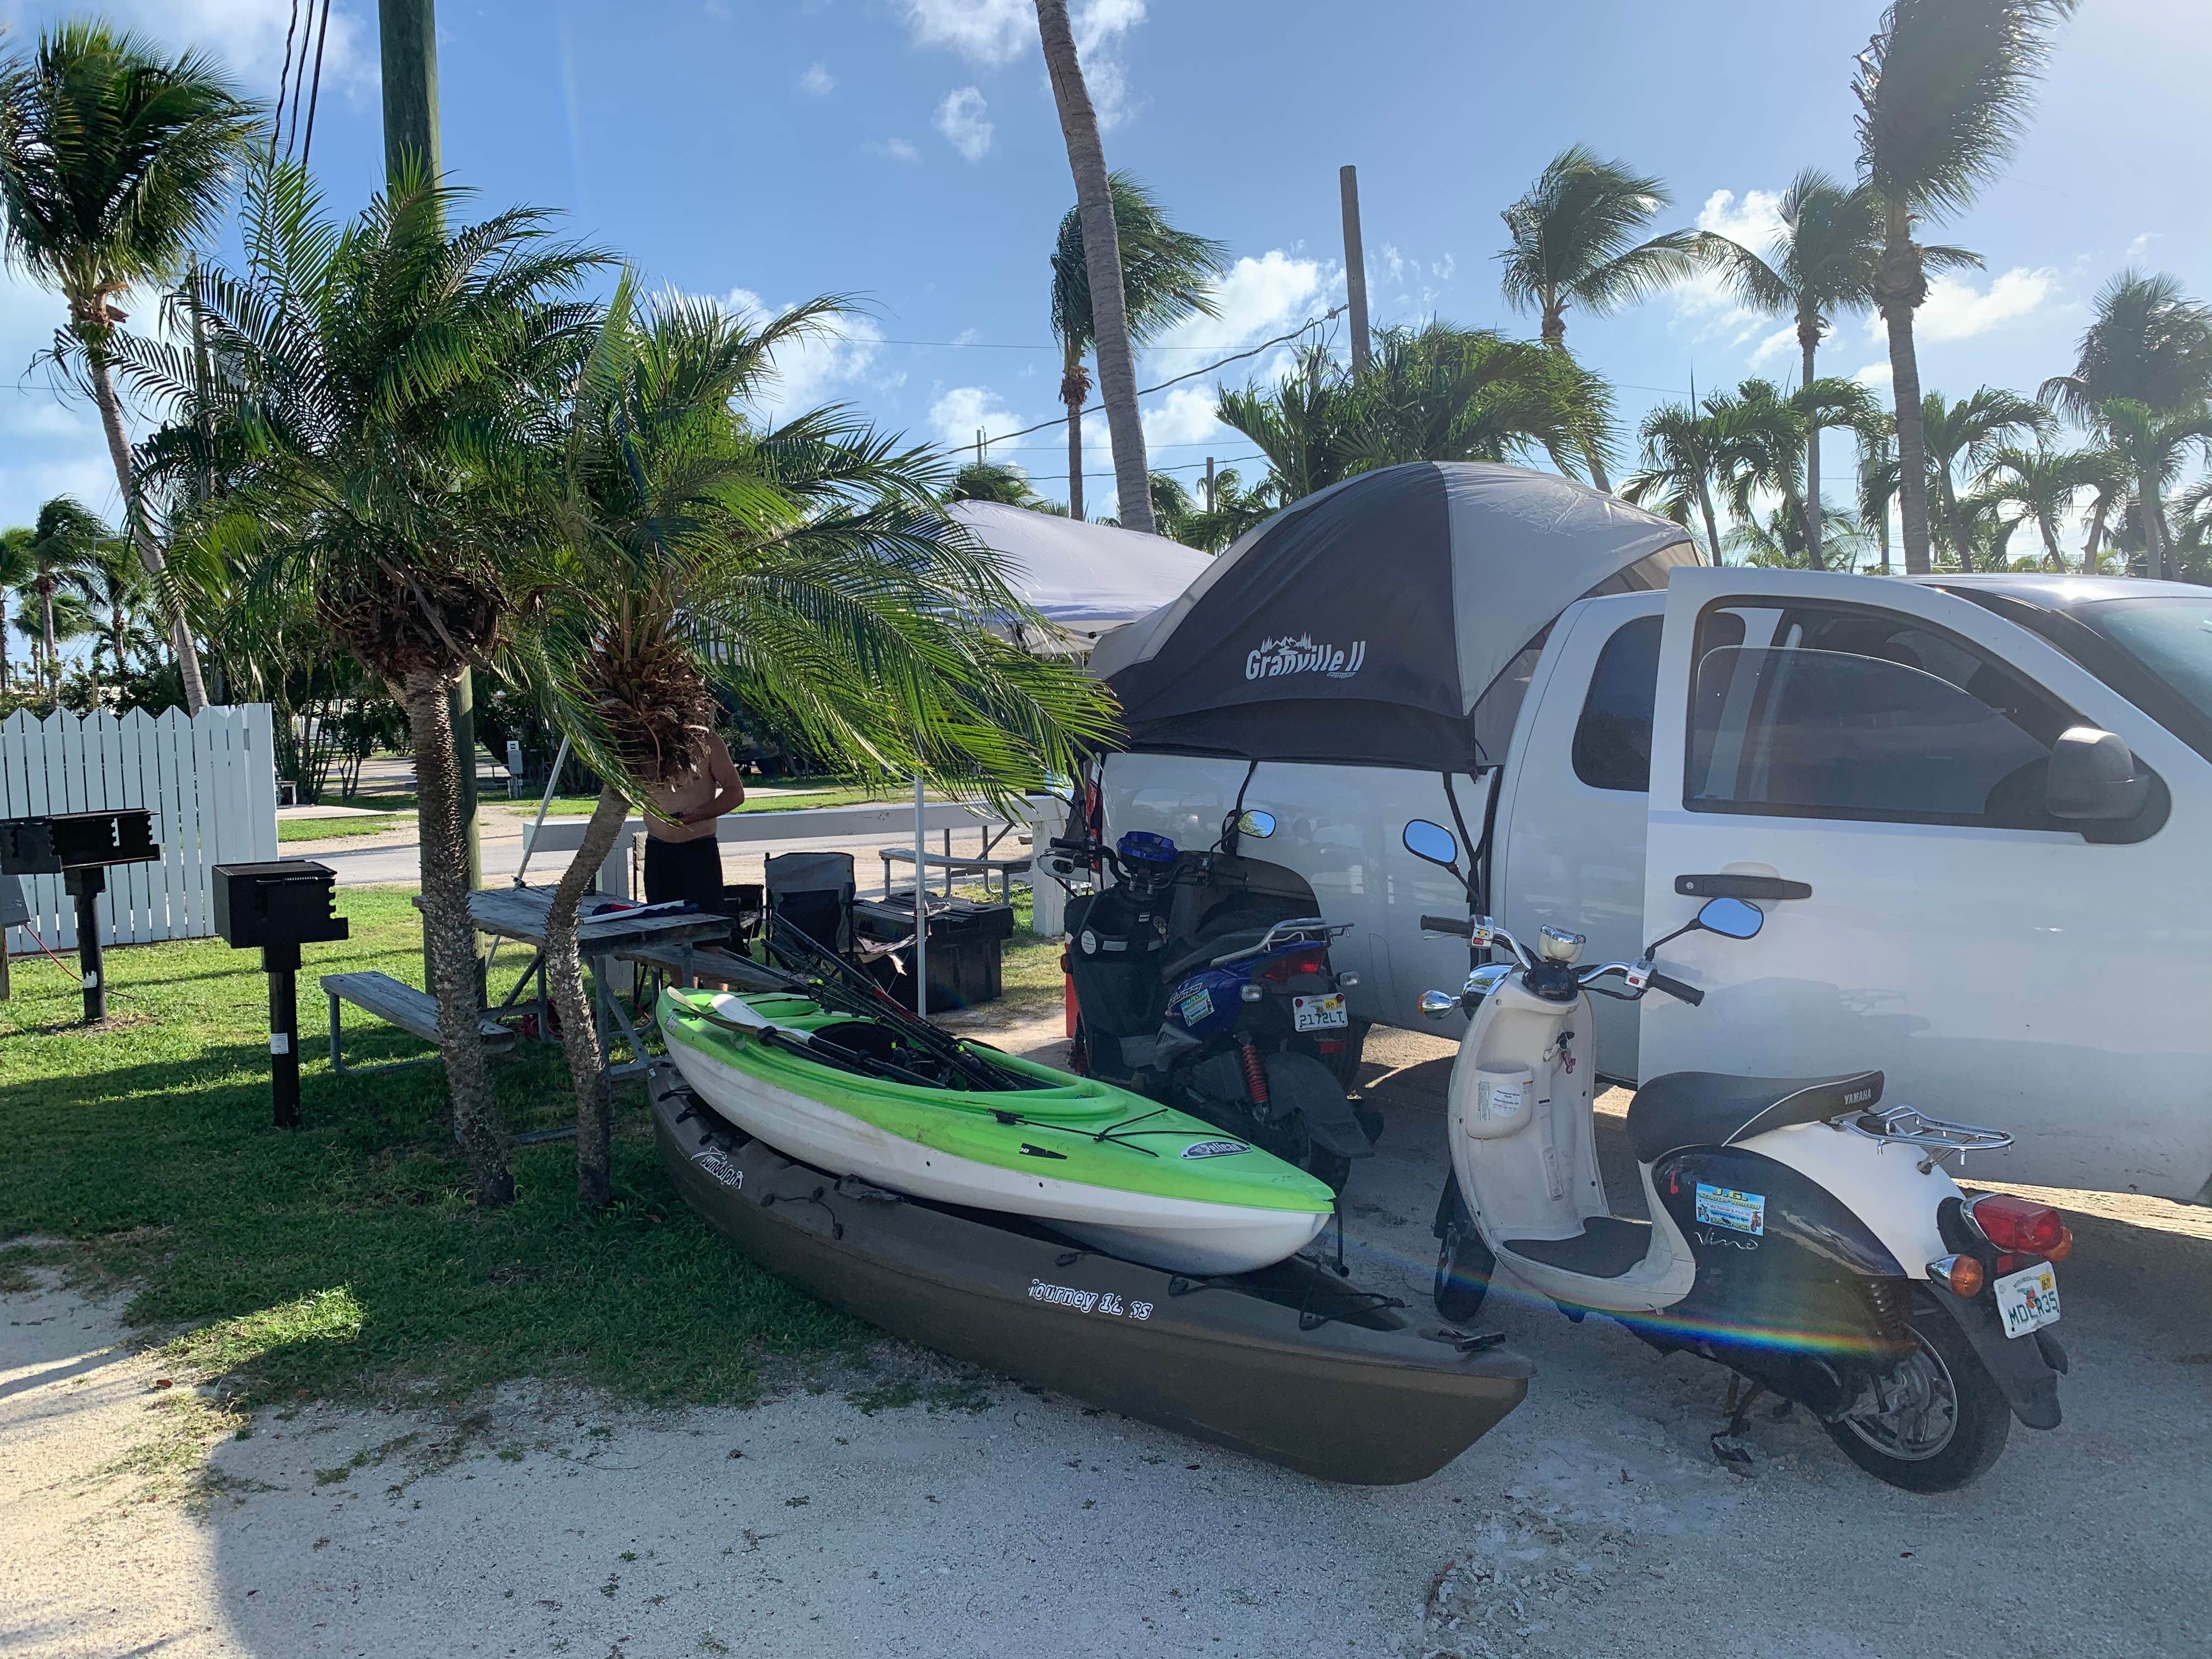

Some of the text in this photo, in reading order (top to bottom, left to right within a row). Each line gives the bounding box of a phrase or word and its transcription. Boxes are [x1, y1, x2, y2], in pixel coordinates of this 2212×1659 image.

[1245, 641, 1365, 680] Granville II
[1300, 1011, 1342, 1025] 2172LT
[1844, 1088, 1871, 1105] YAMAHA
[1712, 1188, 1748, 1201] J.G.
